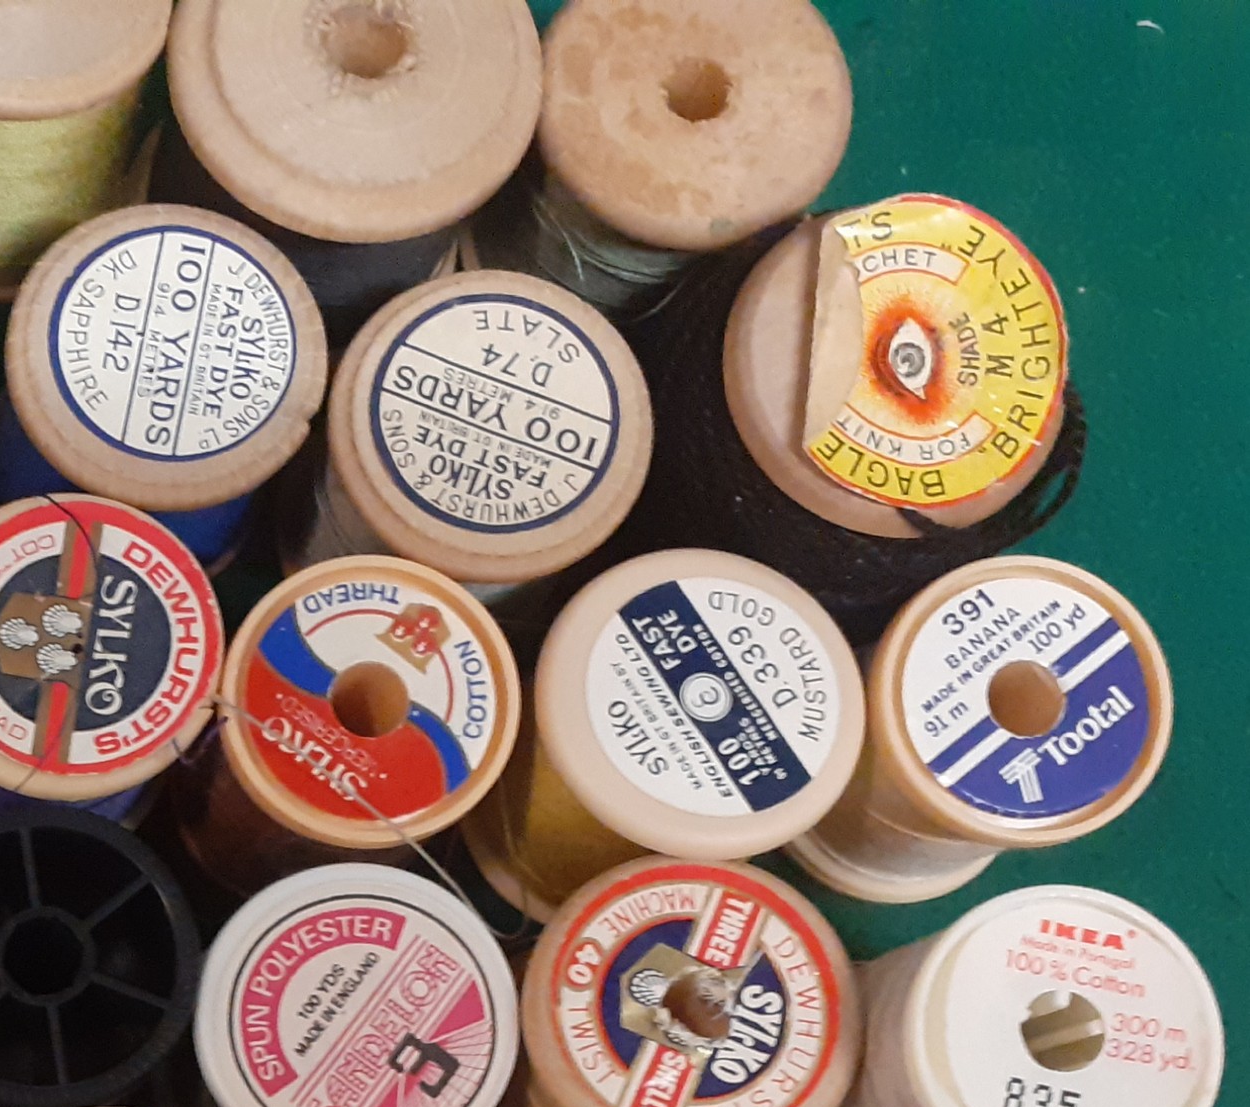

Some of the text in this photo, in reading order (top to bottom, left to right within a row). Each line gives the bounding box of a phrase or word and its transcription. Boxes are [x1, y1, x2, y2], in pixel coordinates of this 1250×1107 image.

[65, 278, 108, 410] SAPPHIRE
[144, 243, 205, 446] 100 YARDS
[201, 286, 242, 417] FAST DYE
[230, 316, 265, 399] SYLKO
[472, 309, 579, 362] SLATE
[948, 311, 979, 385] SHADE
[392, 364, 597, 460] 100 YARDS
[918, 432, 970, 459] FOR
[412, 423, 547, 488] FAST DYE
[429, 454, 513, 499] SYLKO
[302, 582, 400, 613] THREAD
[942, 588, 994, 635] 391
[1027, 603, 1086, 654] 100 yd
[86, 575, 137, 714] SYLKO
[632, 609, 697, 669] FAST DYE
[708, 590, 825, 741] MUSTARD GOLD
[727, 625, 797, 707] D.339
[944, 607, 1021, 669] BANANA
[455, 640, 487, 739] COTTON
[1037, 685, 1134, 765] Tootal
[607, 700, 668, 775] SYLKO
[923, 718, 947, 737] 91
[705, 897, 751, 966] THREE
[245, 915, 393, 1081] SPUN POLYESTER
[317, 963, 344, 999] YDS
[1007, 949, 1145, 997] 100 Cotton
[710, 984, 783, 1084] SYLKO
[1113, 1013, 1158, 1037] 300
